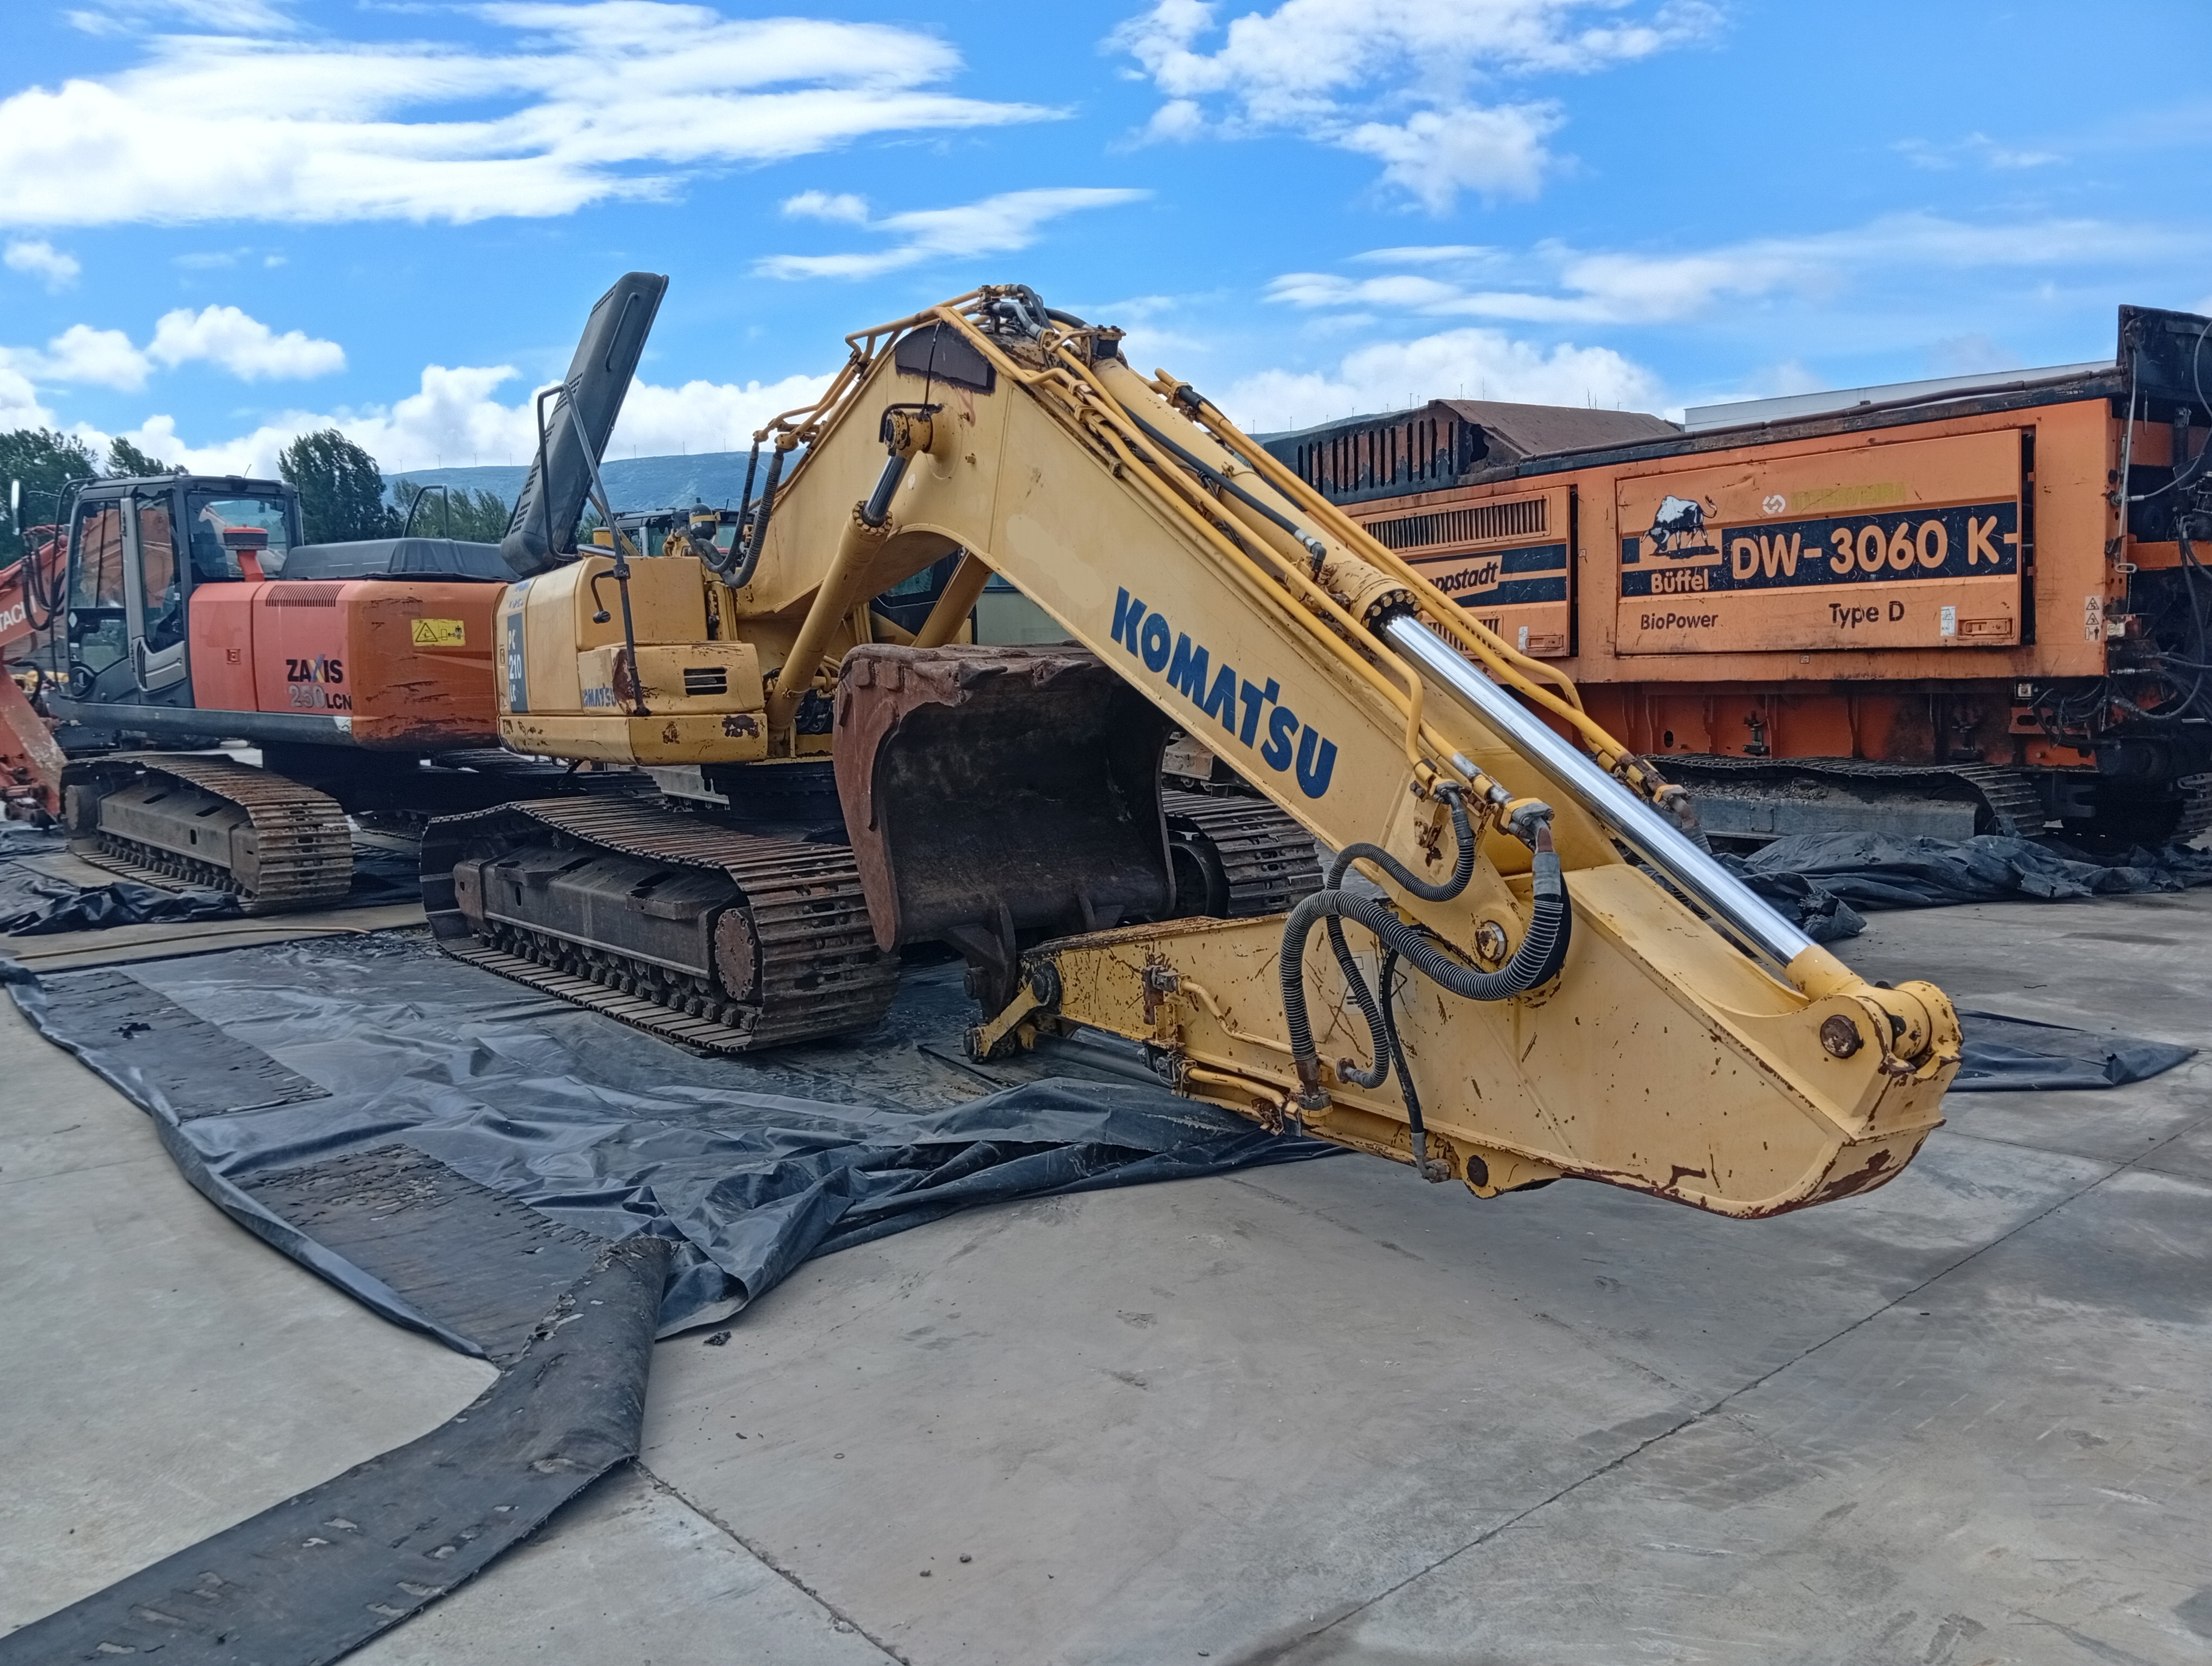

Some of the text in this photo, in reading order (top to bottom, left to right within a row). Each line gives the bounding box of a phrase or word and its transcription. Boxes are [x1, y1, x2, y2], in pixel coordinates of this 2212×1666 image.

[1427, 561, 1499, 595] ppstadt
[1651, 568, 1709, 593] Büffel
[1641, 613, 1719, 630] BioPower
[1829, 601, 1905, 629] Type D
[508, 629, 516, 650] PC
[286, 653, 343, 684] ZAXIS
[509, 654, 522, 680] 210
[1110, 586, 1338, 799] KOMATSU
